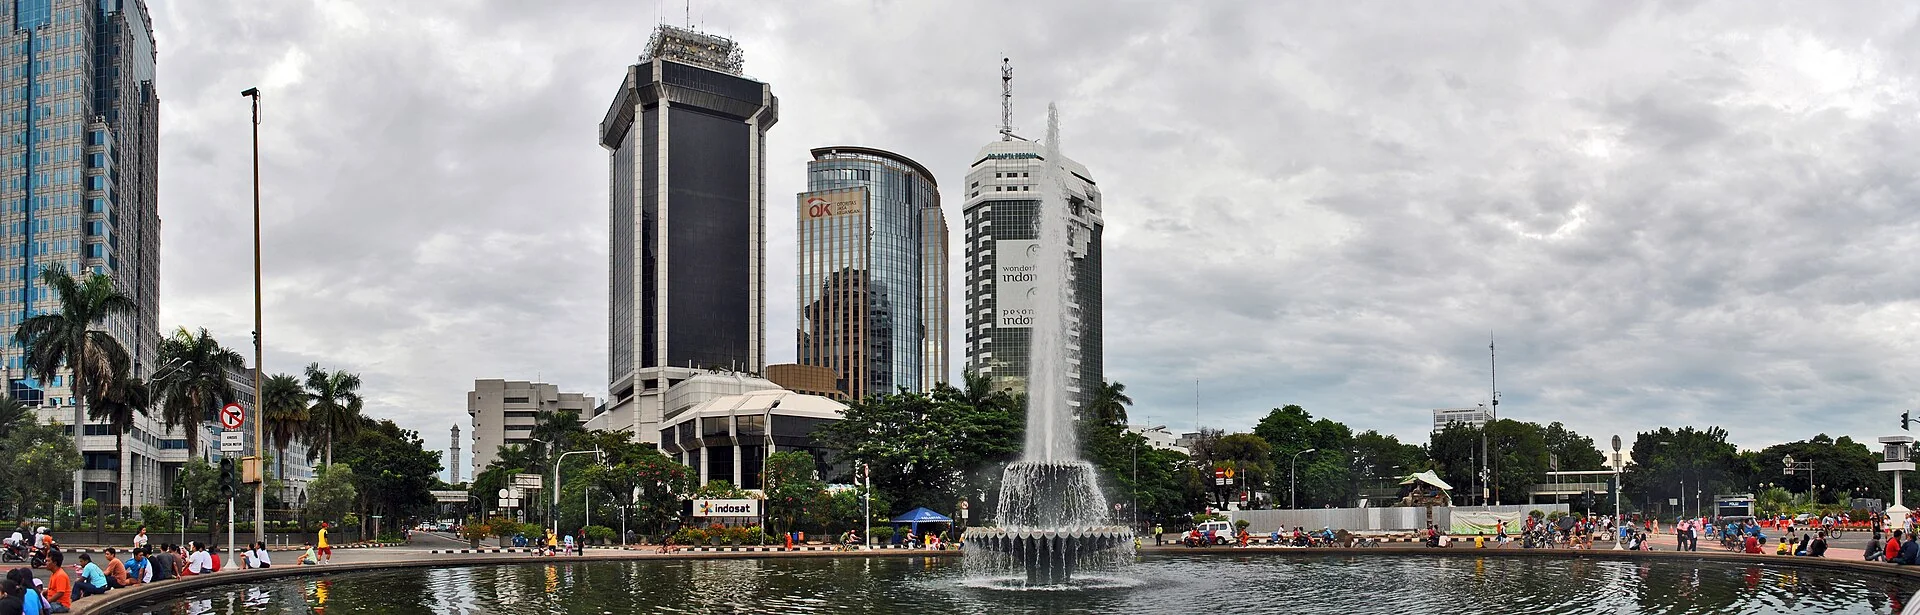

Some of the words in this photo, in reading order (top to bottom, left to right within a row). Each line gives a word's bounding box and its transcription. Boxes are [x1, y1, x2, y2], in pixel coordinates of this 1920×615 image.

[1002, 272, 1037, 282] indon
[1002, 308, 1034, 316] peson
[715, 503, 751, 513] indosat
